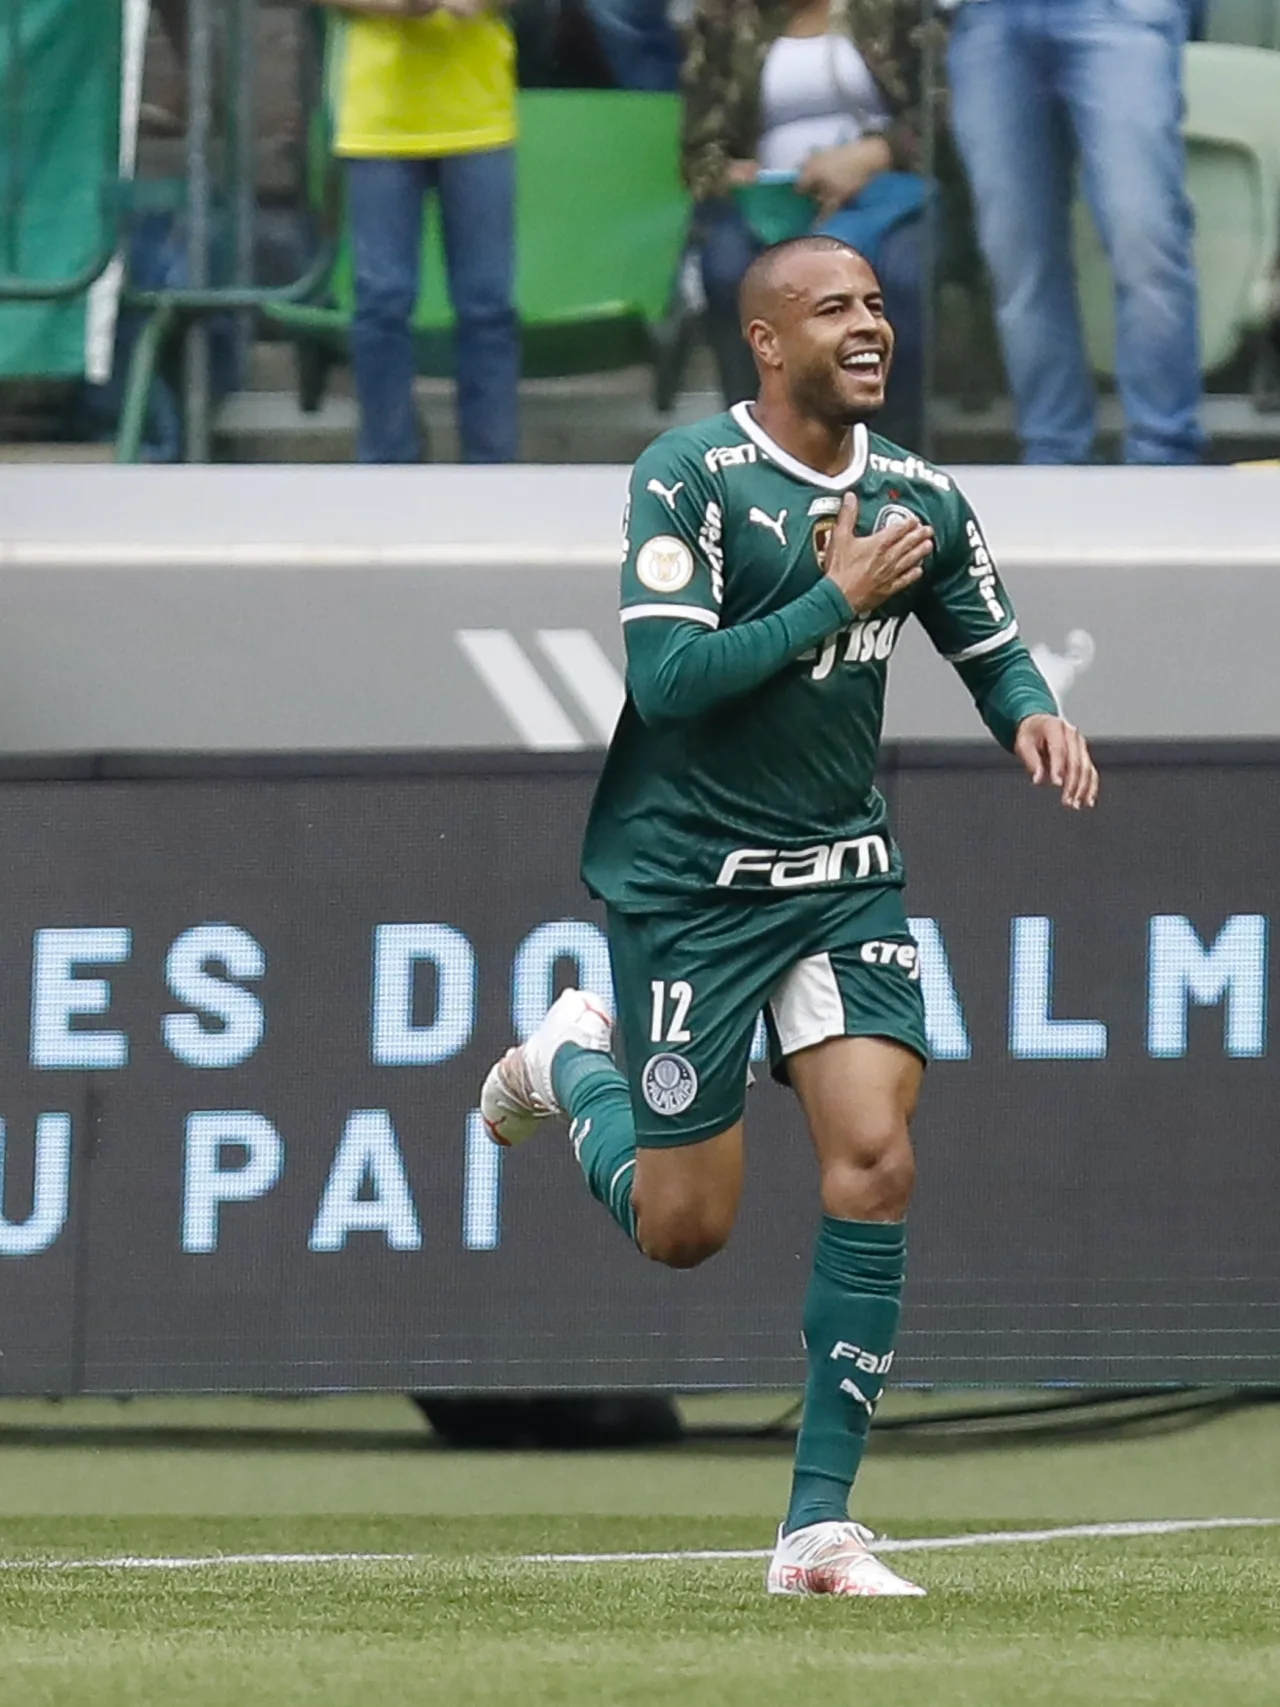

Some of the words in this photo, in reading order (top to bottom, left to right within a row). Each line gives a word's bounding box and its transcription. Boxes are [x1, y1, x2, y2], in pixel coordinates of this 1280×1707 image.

[29, 924, 267, 1069] ES
[371, 921, 617, 1066] DO
[650, 980, 693, 1042] 12
[182, 1108, 502, 1253] PAI
